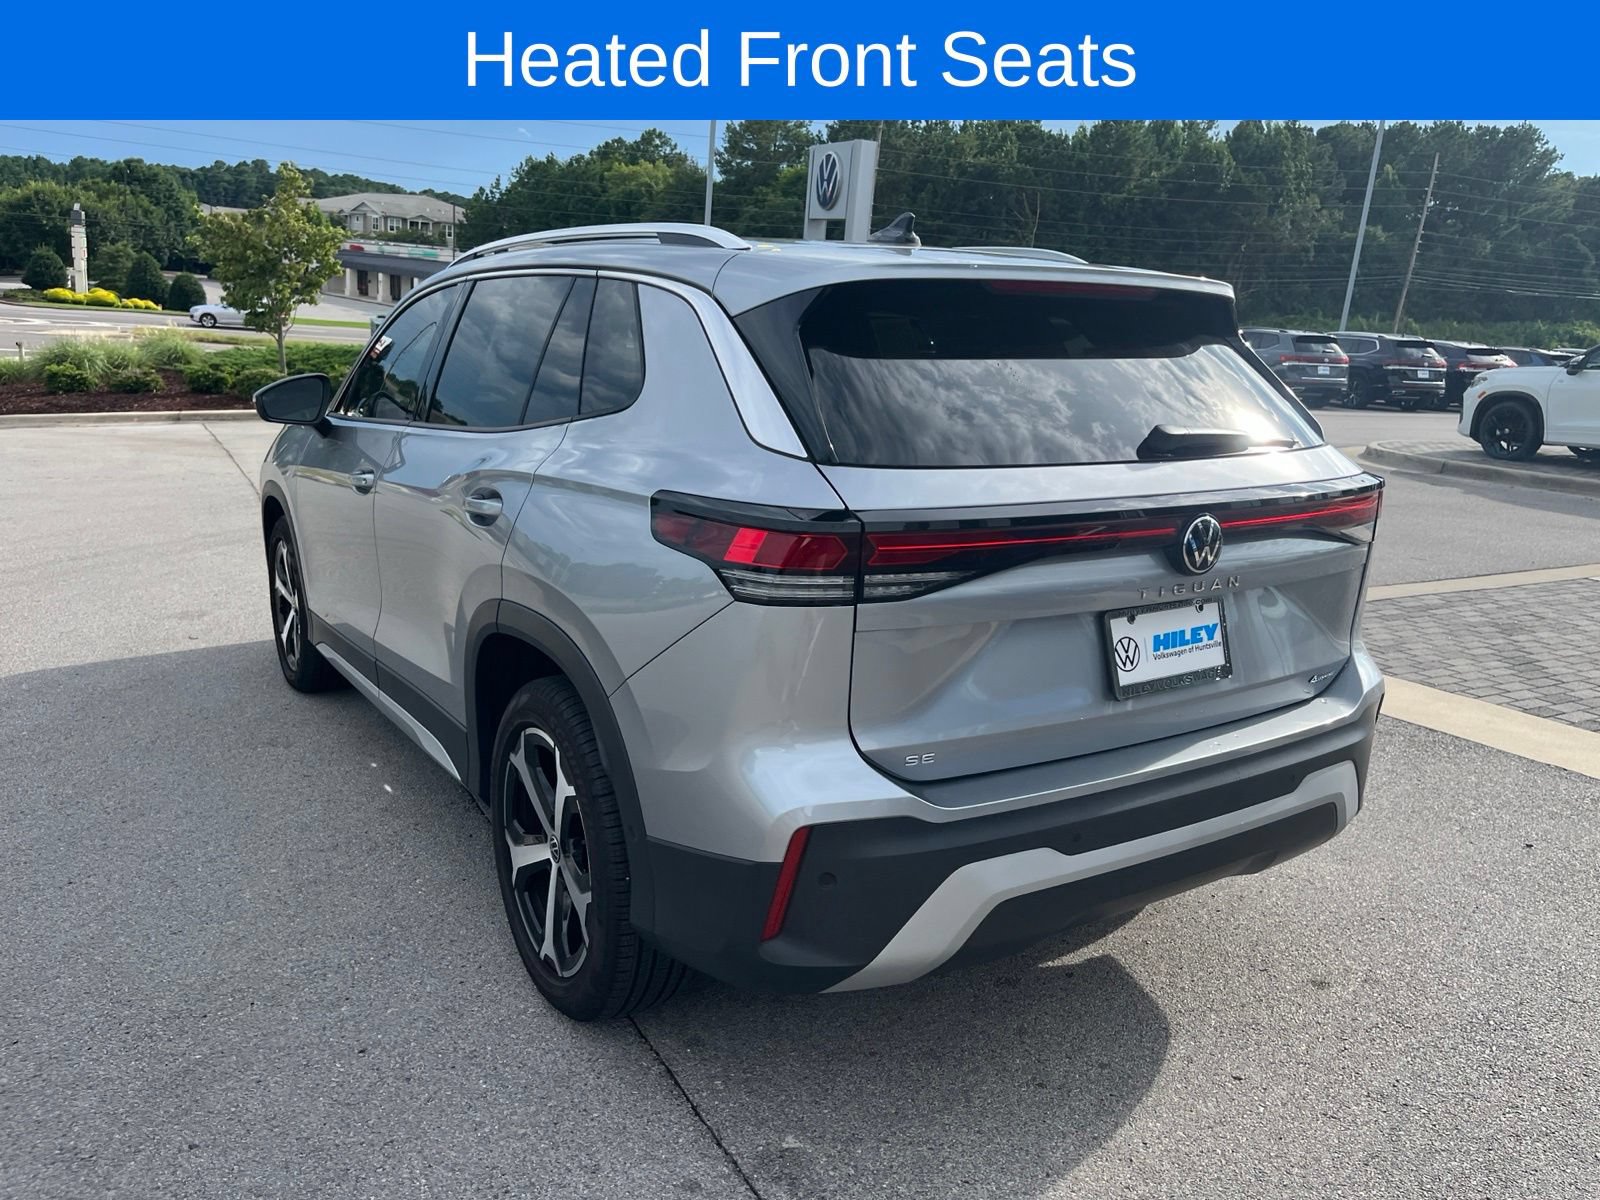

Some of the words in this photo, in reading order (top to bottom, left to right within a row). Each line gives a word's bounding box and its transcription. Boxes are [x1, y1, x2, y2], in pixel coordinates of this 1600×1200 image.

[1137, 575, 1240, 600] TIGUAN
[1153, 623, 1219, 652] HILEY
[1152, 649, 1188, 661] Volkswagen
[1188, 645, 1195, 653] of
[1195, 640, 1222, 652] Huntsville
[1156, 668, 1229, 690] VOLKSWAG
[905, 753, 936, 767] SE
